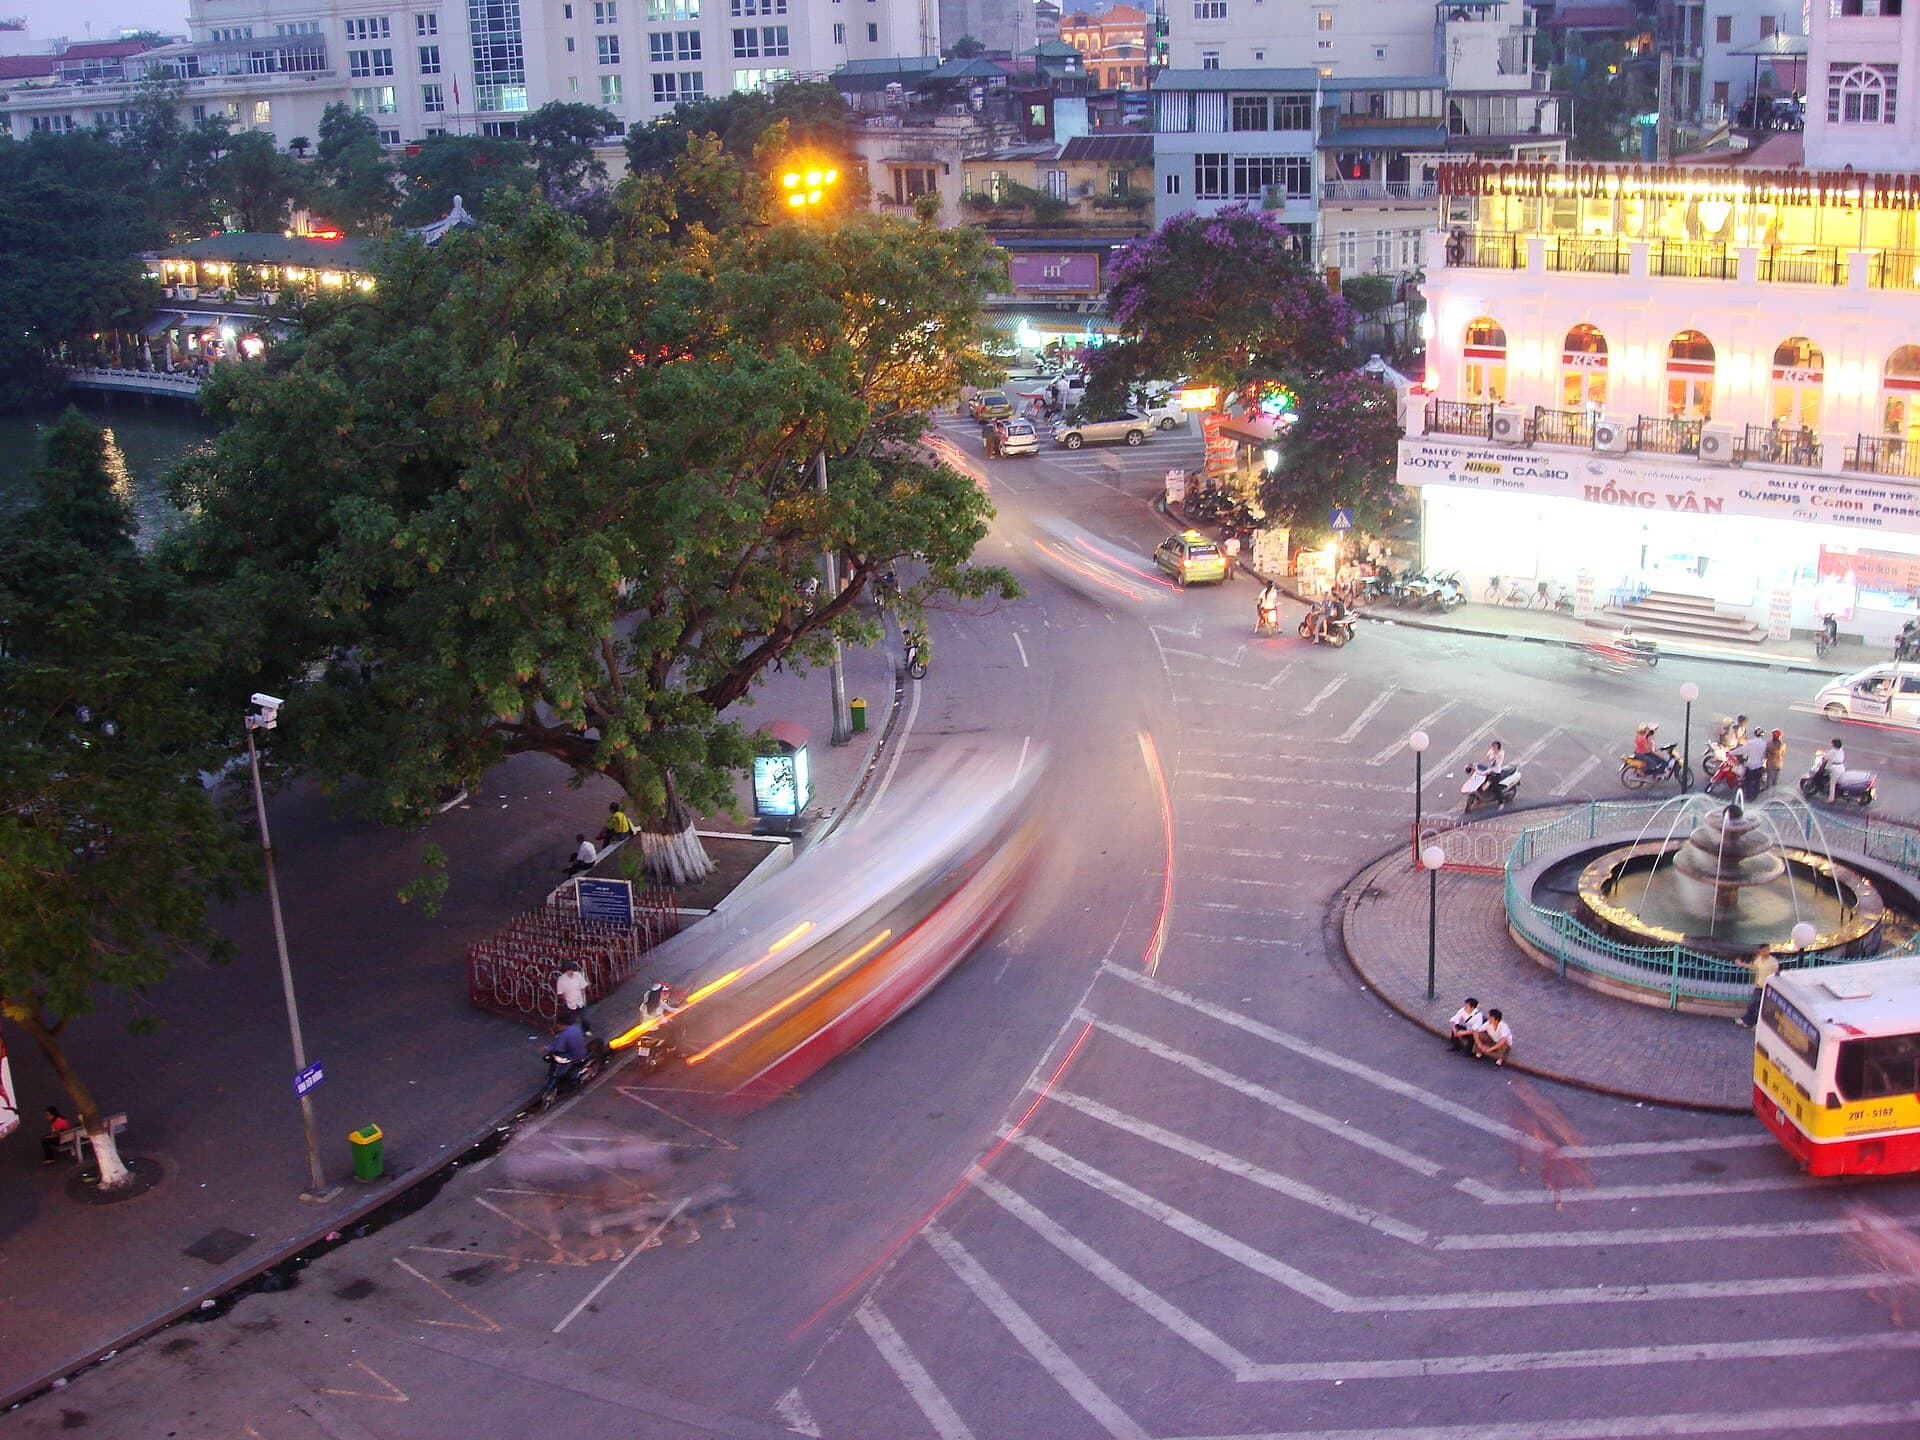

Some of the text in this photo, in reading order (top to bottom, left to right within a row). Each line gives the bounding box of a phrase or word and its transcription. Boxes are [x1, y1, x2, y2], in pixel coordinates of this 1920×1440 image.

[1573, 355, 1601, 368] KFC
[1784, 369, 1814, 382] KFC
[1463, 462, 1501, 475] Nikon
[1584, 479, 1724, 513] HỒNG VÂN
[1810, 494, 1863, 511] Canon
[1832, 513, 1882, 526] SAMSUNG
